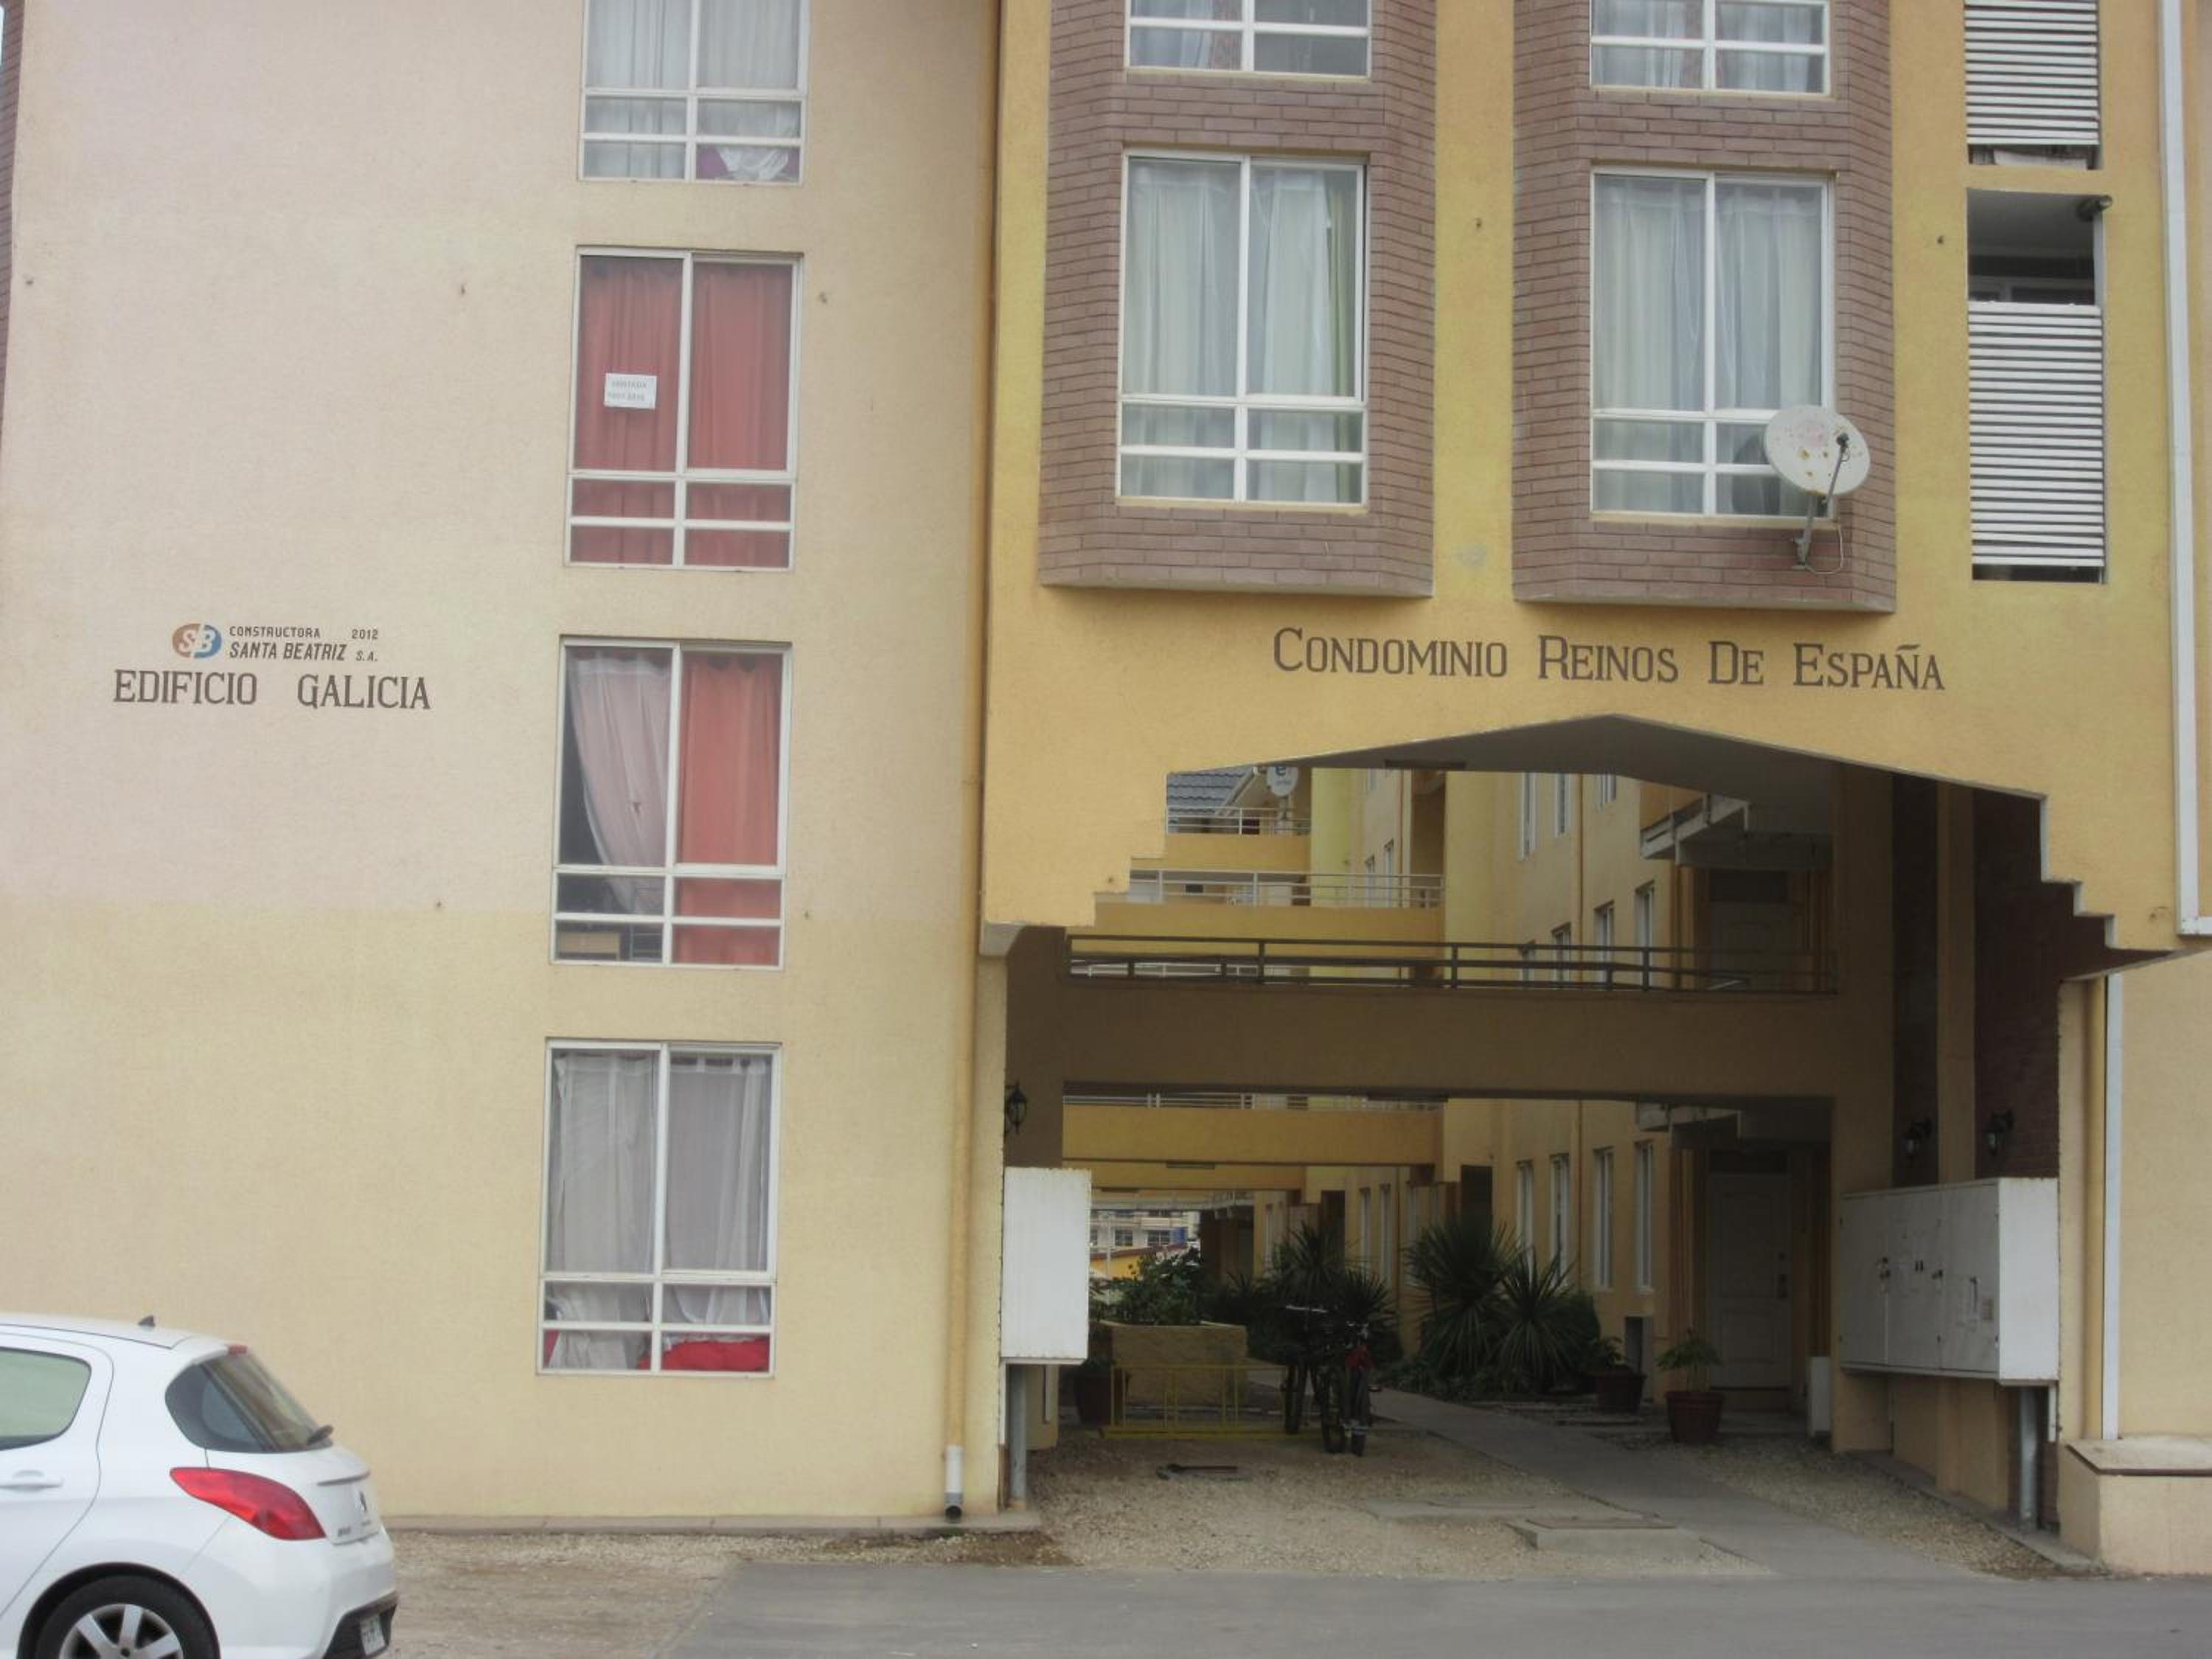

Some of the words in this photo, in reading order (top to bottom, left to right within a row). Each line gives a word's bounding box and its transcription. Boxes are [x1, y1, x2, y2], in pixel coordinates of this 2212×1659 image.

[229, 626, 321, 639] CONSTRUCTORA
[352, 629, 378, 639] 2012
[229, 641, 277, 659] SANTA
[282, 642, 347, 661] BEATRIZ
[1273, 627, 1507, 678] CONDOMINIO
[1538, 635, 1679, 683] REINOS
[1708, 641, 1764, 685] DE
[1792, 642, 1945, 690] ESPAÑA
[114, 669, 257, 705] EDIFICIO
[297, 674, 431, 709] GALICIA
